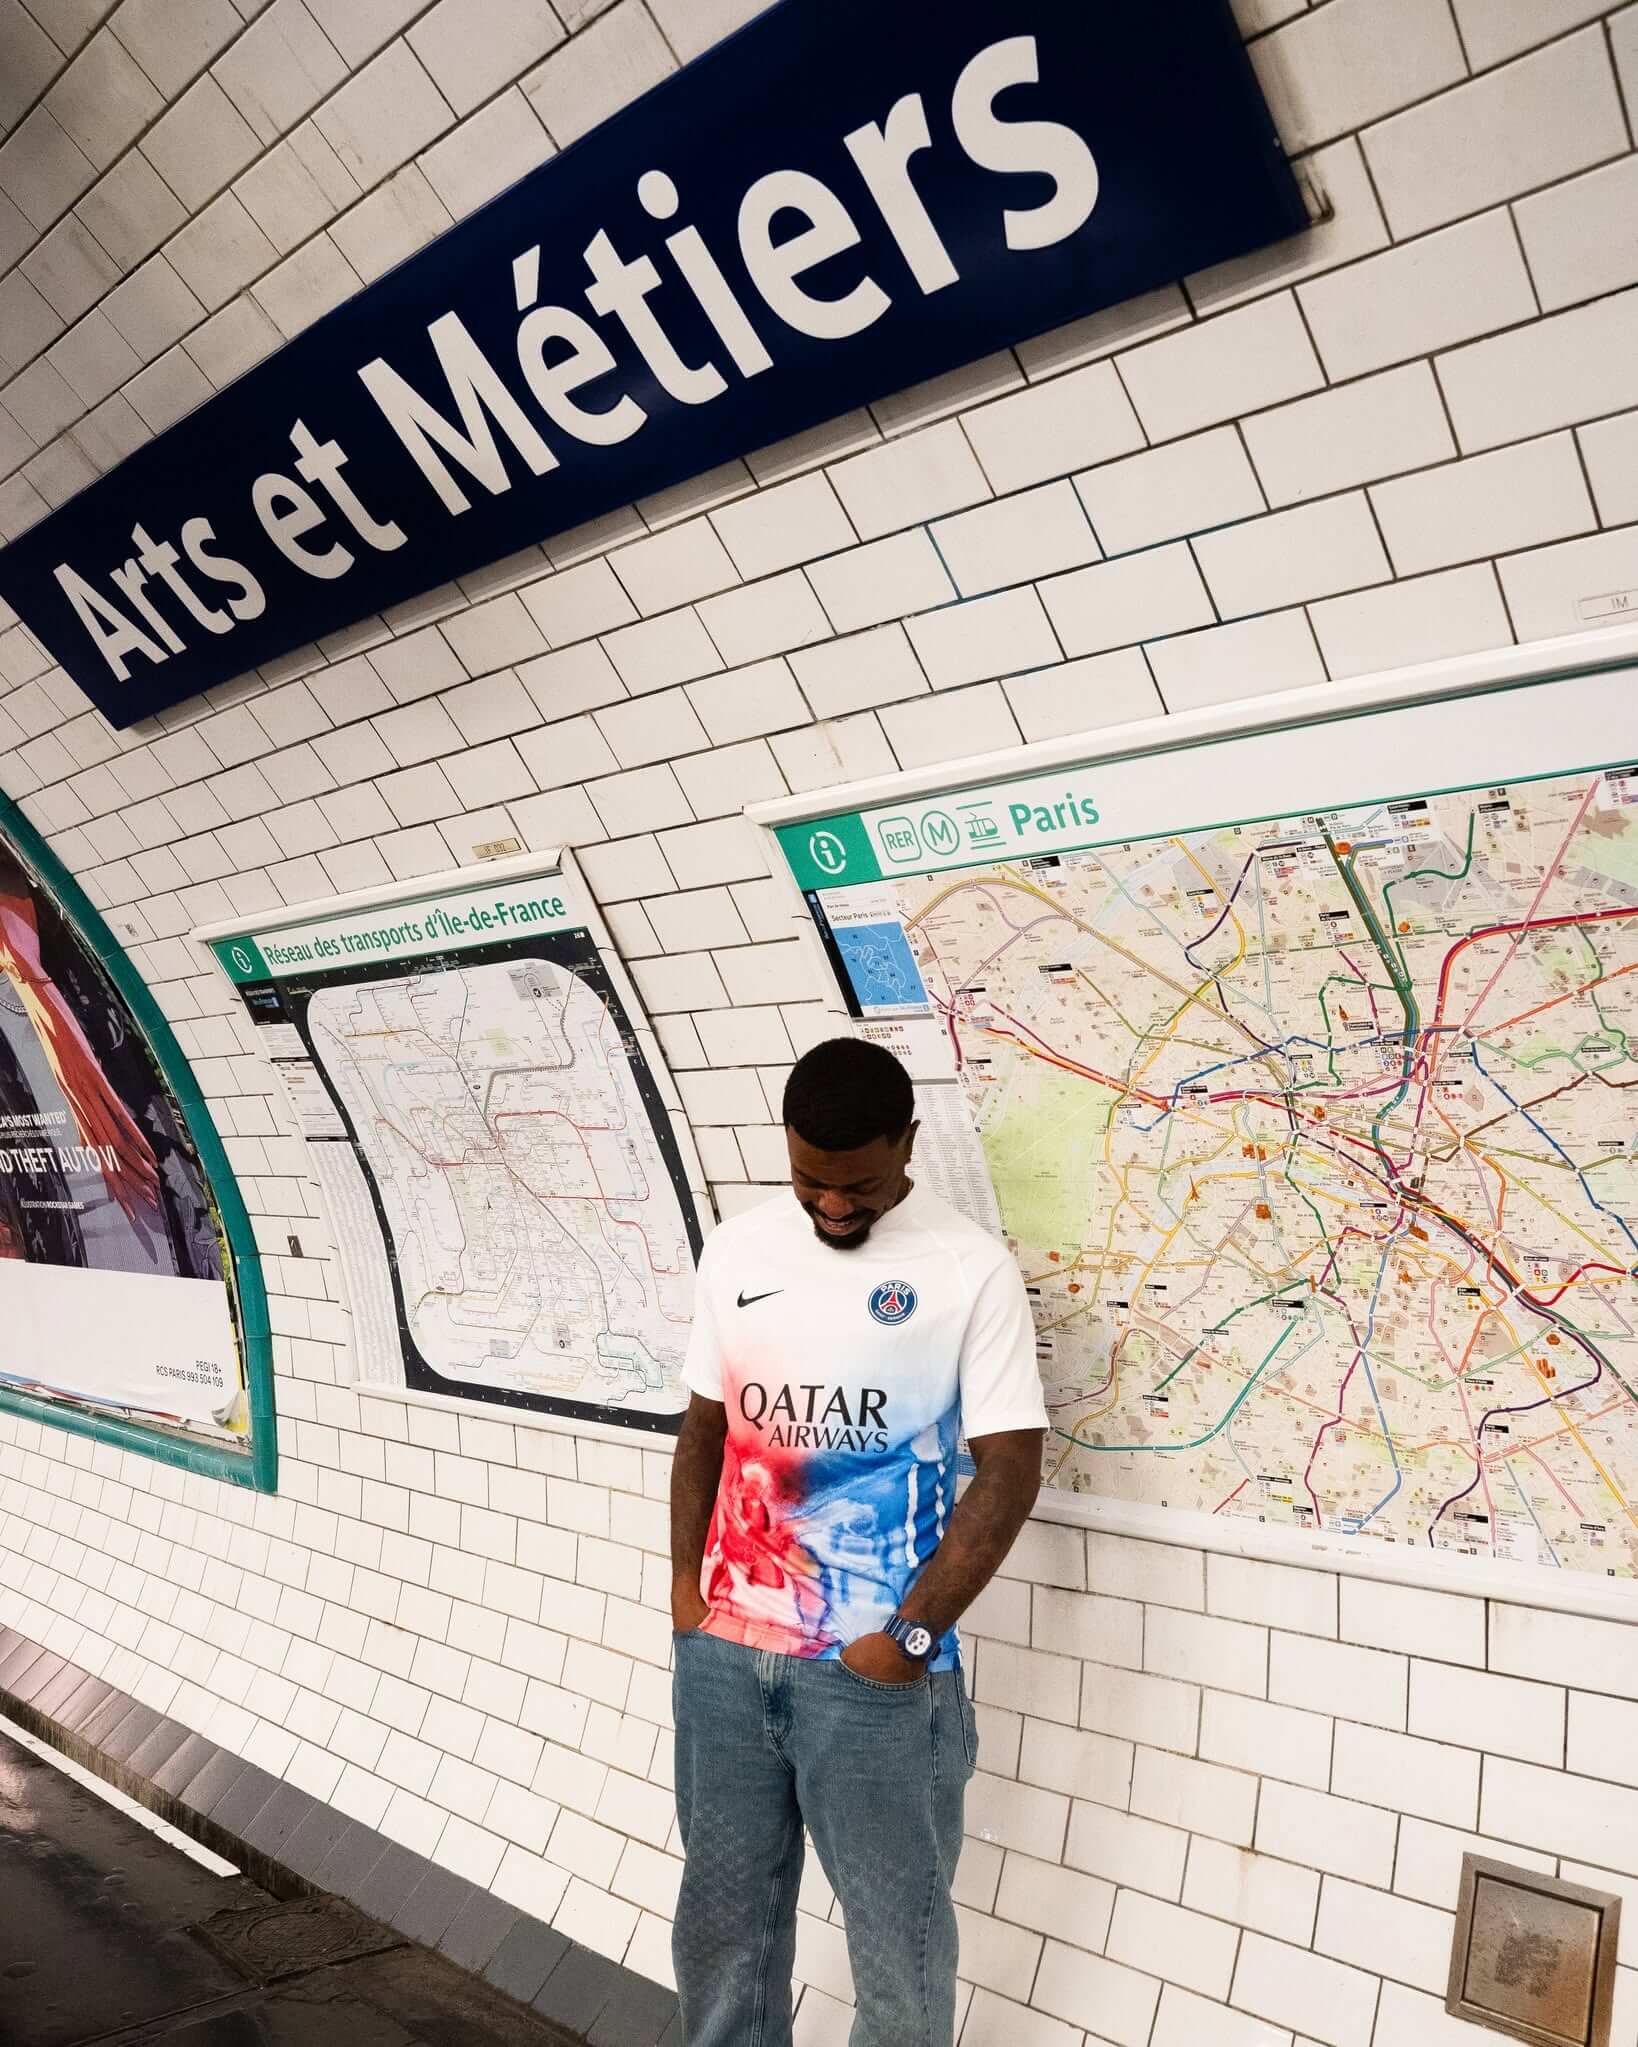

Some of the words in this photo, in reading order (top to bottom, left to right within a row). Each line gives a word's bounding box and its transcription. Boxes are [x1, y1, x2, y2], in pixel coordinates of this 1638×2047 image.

[53, 518, 266, 682] Arts
[252, 418, 409, 579] et
[357, 35, 1099, 516] Métiers
[886, 830, 914, 848] RER
[928, 819, 953, 846] M
[1008, 792, 1100, 836] Paris
[263, 942, 313, 965] Réseau
[313, 936, 341, 958] des
[340, 921, 423, 952] transports
[10, 1147, 58, 1173] THEFT
[58, 1146, 102, 1173] AUTO
[98, 1145, 122, 1172] VI
[880, 1283, 911, 1296] PARIS
[740, 1382, 888, 1432] QATAR
[768, 1423, 889, 1454] AIRWAYS
